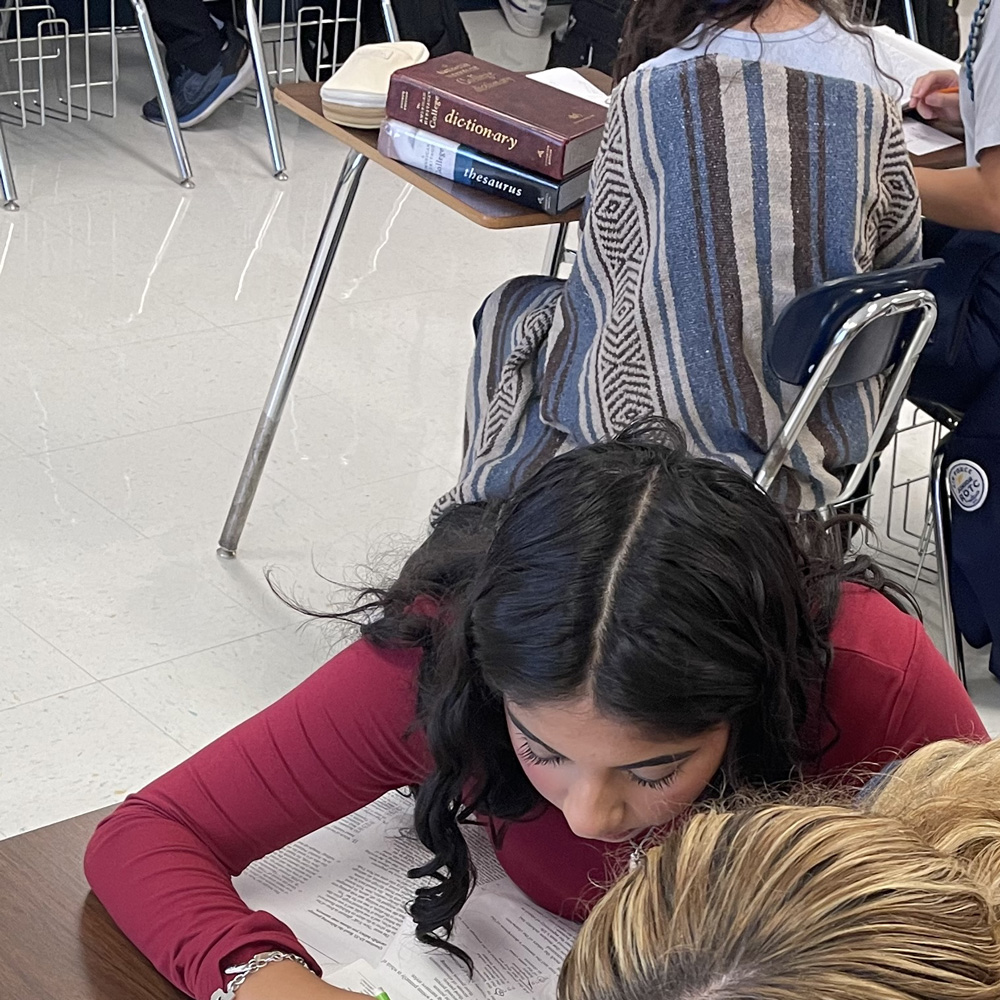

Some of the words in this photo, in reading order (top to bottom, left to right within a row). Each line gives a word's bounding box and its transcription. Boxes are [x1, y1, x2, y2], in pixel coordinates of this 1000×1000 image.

[429, 95, 441, 128] College
[463, 167, 523, 197] thesaurus
[959, 480, 981, 502] ROTC
